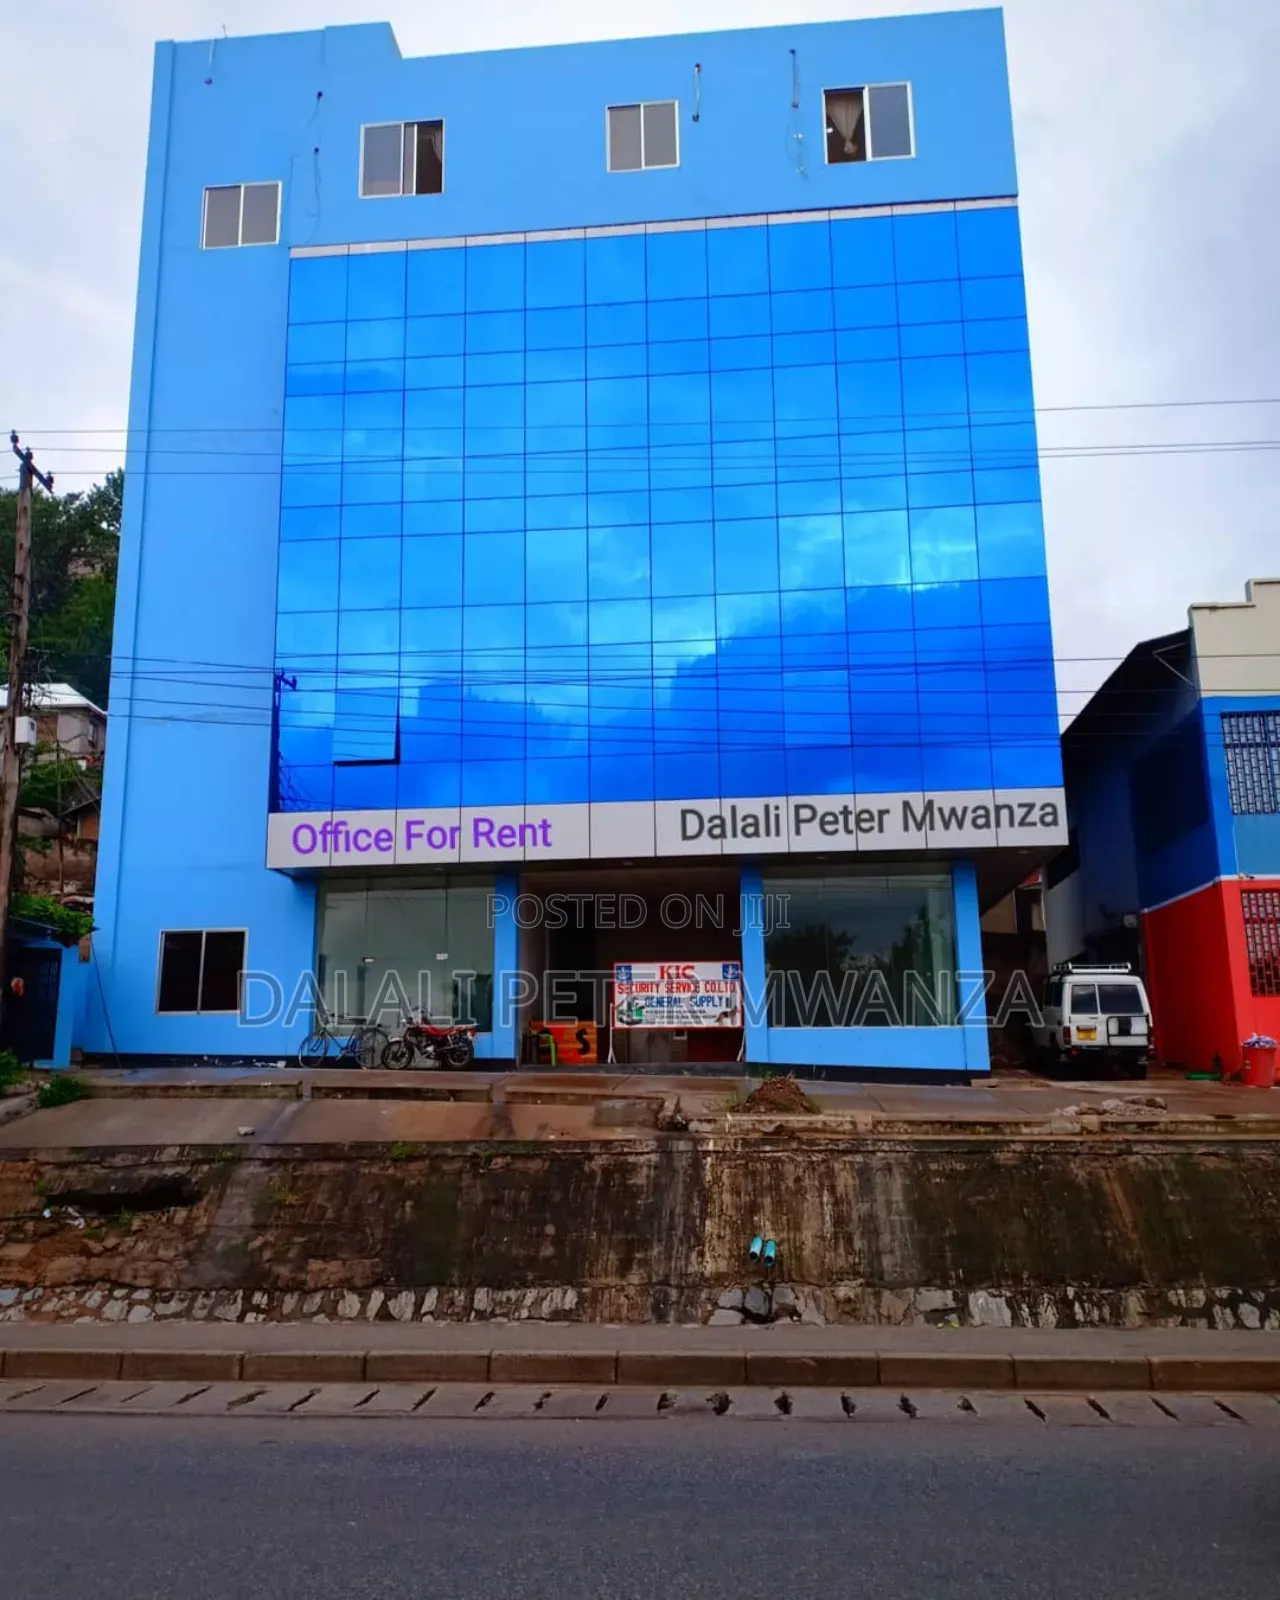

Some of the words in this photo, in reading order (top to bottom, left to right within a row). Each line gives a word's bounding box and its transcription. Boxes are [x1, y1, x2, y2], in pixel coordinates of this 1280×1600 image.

[680, 804, 782, 841] Dalali
[794, 804, 891, 837] Peter
[902, 799, 1060, 833] Mwanza
[292, 820, 393, 855] Office
[405, 819, 462, 851] For
[473, 817, 553, 848] Rent
[617, 981, 660, 995] SECURITY
[645, 996, 683, 1008] GENERAL
